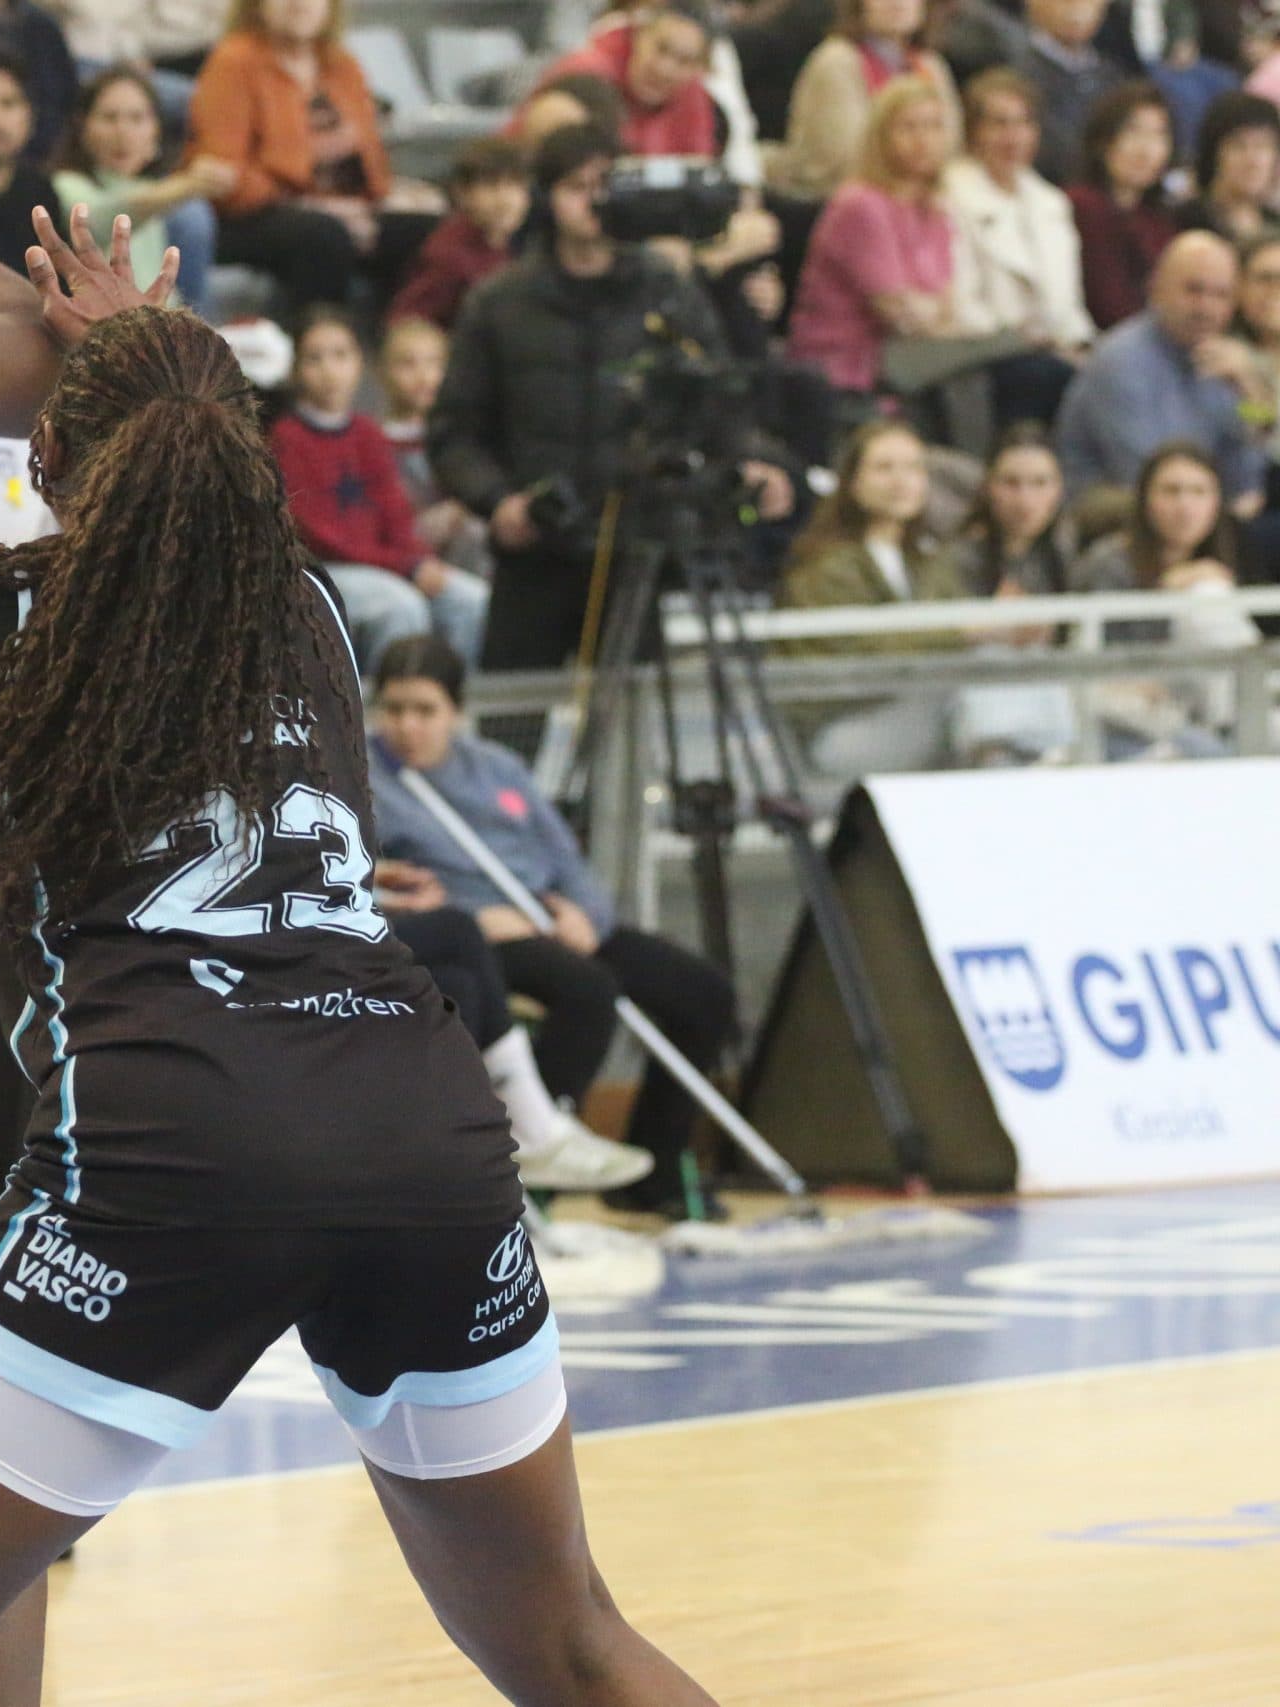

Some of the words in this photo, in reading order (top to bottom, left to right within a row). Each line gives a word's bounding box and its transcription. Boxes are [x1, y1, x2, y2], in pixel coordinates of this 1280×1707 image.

[126, 782, 389, 944] 23
[37, 1214, 72, 1239] EL
[16, 1253, 112, 1323] VASCO
[26, 1228, 129, 1297] DIARIO
[467, 1305, 526, 1342] Oarso
